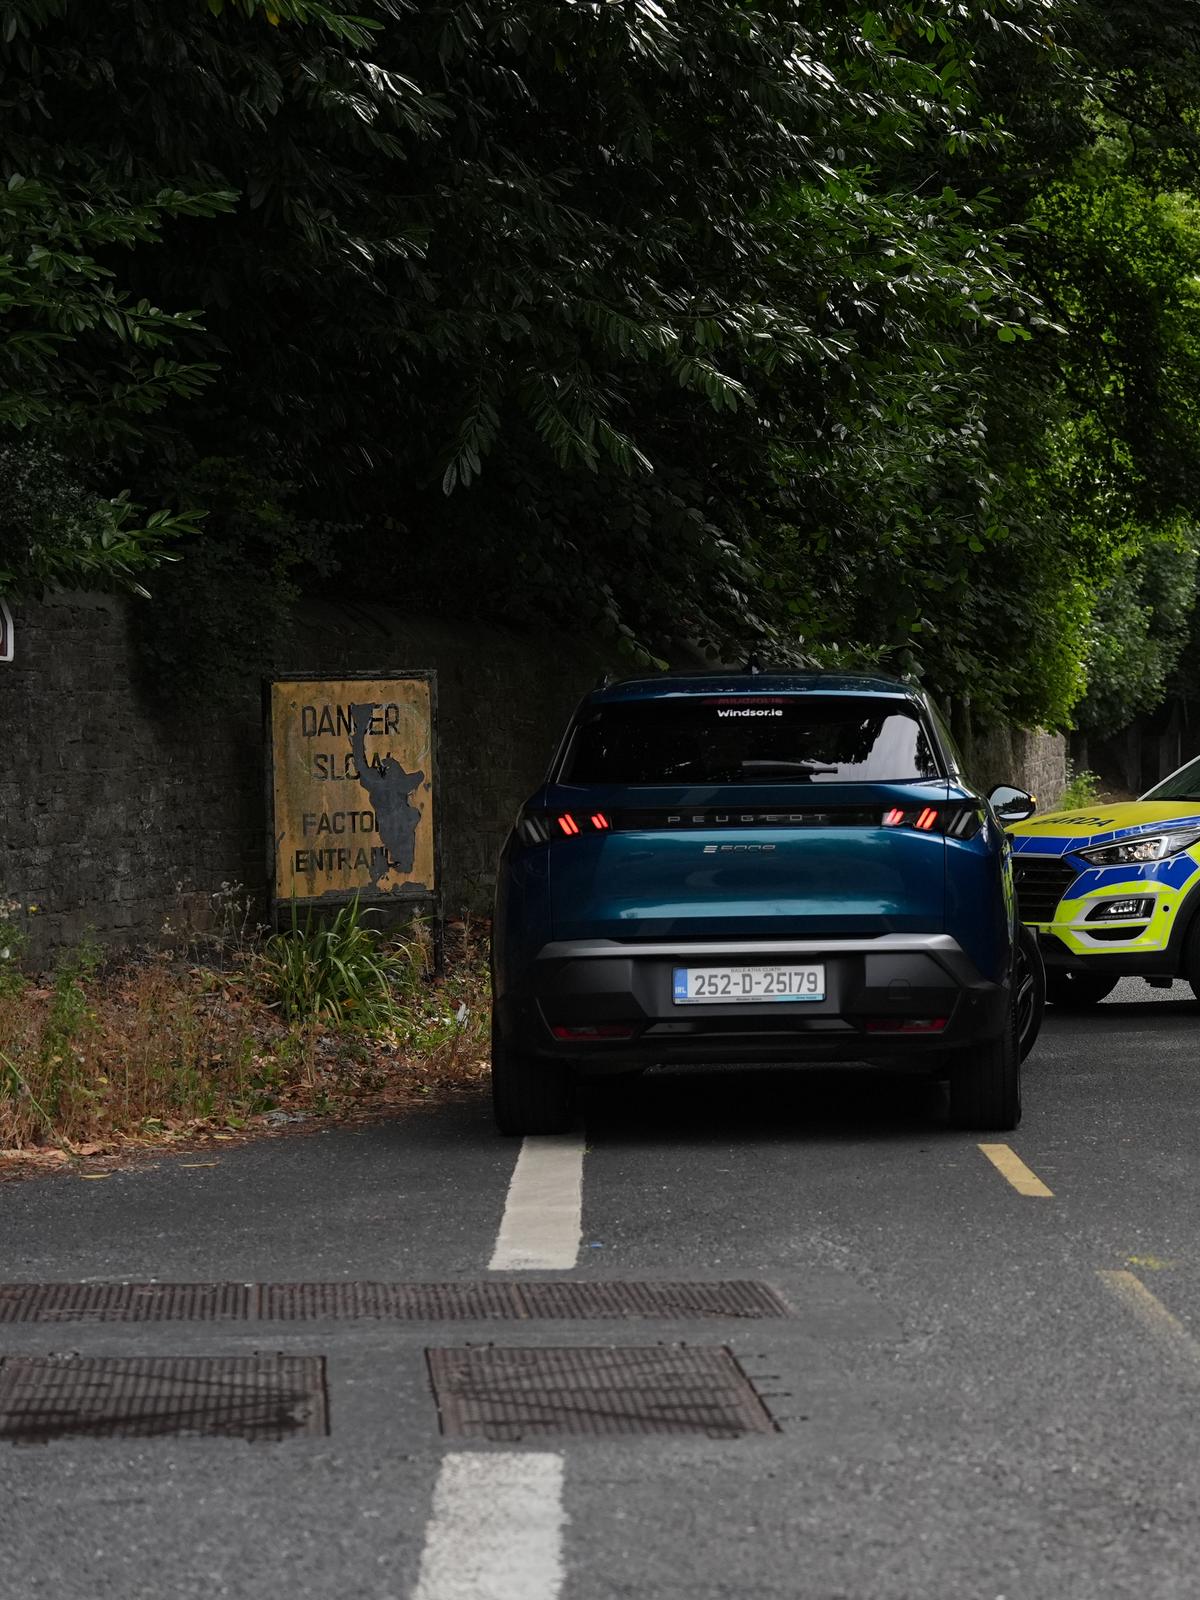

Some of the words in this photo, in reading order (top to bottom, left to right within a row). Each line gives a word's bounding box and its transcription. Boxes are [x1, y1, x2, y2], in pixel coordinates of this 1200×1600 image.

[302, 703, 400, 736] DANER
[717, 708, 783, 717] Windsor.ie
[302, 811, 380, 836] FACTO
[667, 814, 827, 823] PEUGEOT
[694, 972, 818, 996] 252-D-25179
